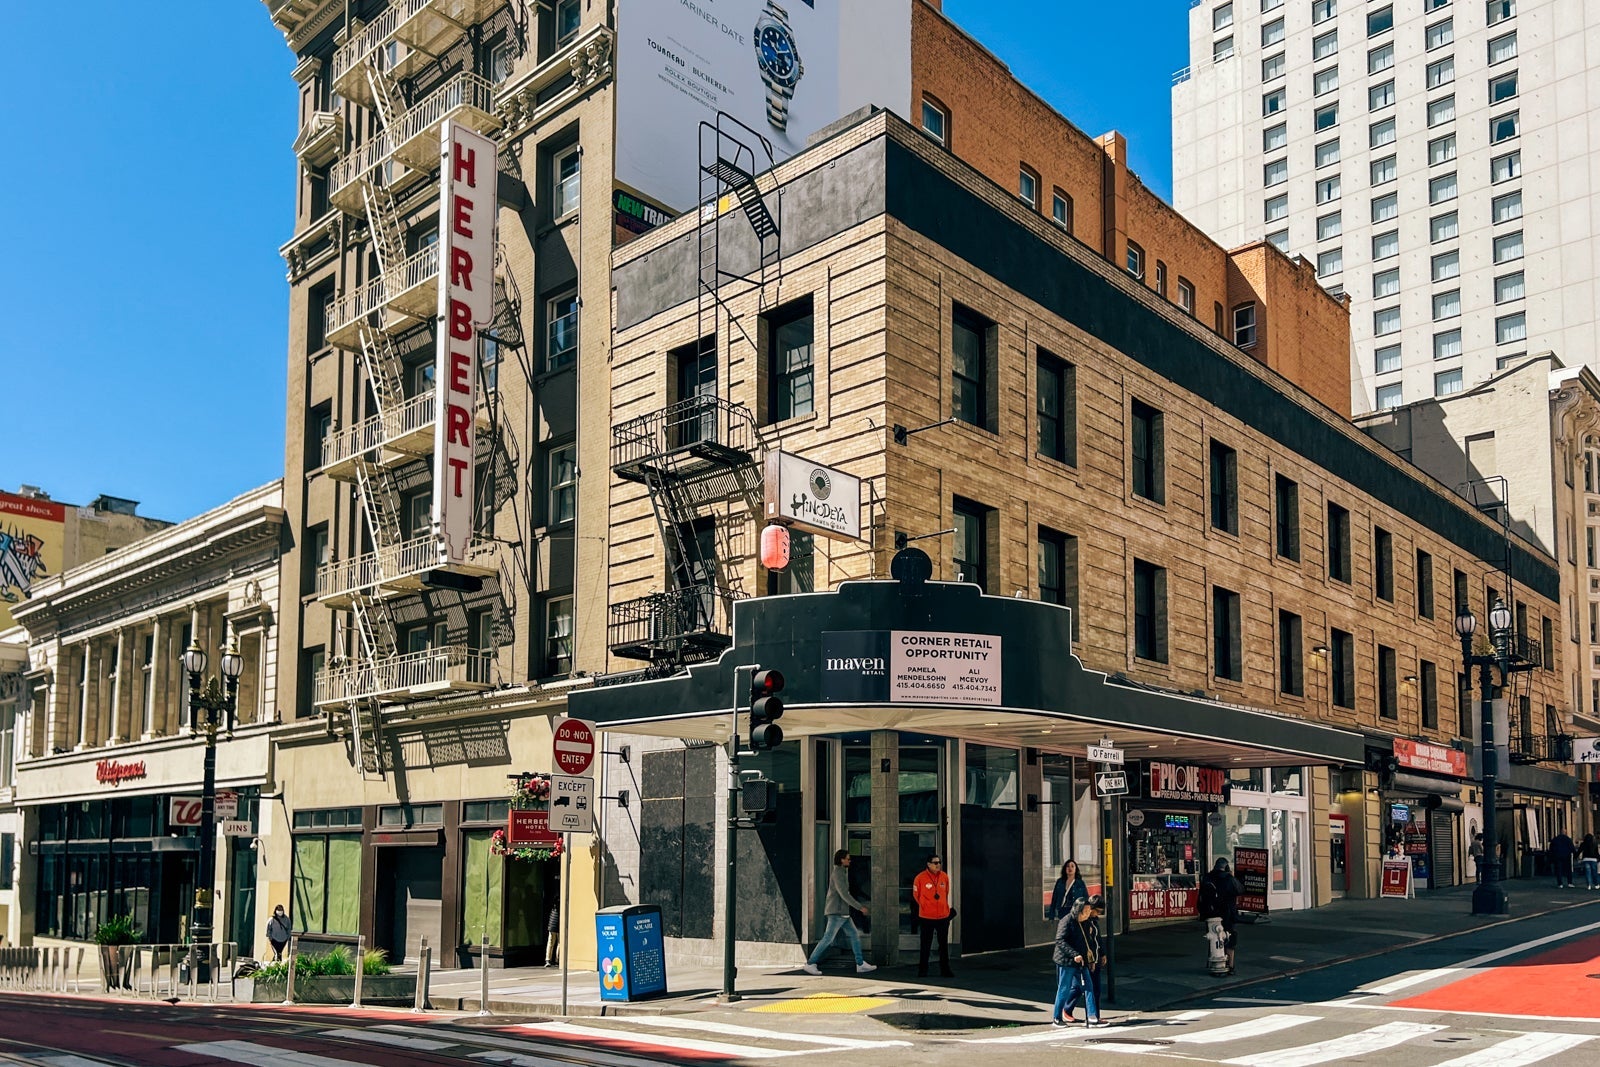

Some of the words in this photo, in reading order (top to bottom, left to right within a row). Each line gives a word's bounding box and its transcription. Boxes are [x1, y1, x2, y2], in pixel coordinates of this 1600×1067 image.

[721, 23, 745, 46] DATE
[647, 38, 685, 67] TOURNEAU
[664, 66, 685, 82] ROLEX
[687, 80, 718, 102] BOUTIQUE
[692, 66, 728, 94] BUCHERER
[449, 142, 476, 498] HERBERT
[0, 500, 23, 511] great
[901, 636, 951, 647] CORNER
[954, 638, 993, 649] RETAIL
[905, 648, 989, 661] OPPORTUNITY
[826, 657, 886, 671] maven
[897, 674, 947, 682] MENDELSOHN
[959, 676, 989, 684] MCEVOY
[896, 682, 946, 690] 415.404.6650
[952, 684, 997, 693] 415.404.7343
[560, 728, 571, 738] DO
[574, 730, 590, 741] NOT
[561, 753, 586, 765] ENTER
[1092, 749, 1120, 761] O'Farrell
[558, 781, 587, 793] EXCEPT
[1104, 779, 1114, 788] ONE
[1160, 789, 1181, 799] PREPAID
[1180, 791, 1192, 800] SIMS
[1193, 793, 1210, 802] PHONE
[1209, 794, 1225, 803] REPAIR
[565, 816, 578, 825] TAXI
[227, 824, 248, 832] JINS
[1235, 850, 1267, 860] PREPAID
[1169, 890, 1187, 908] STOP
